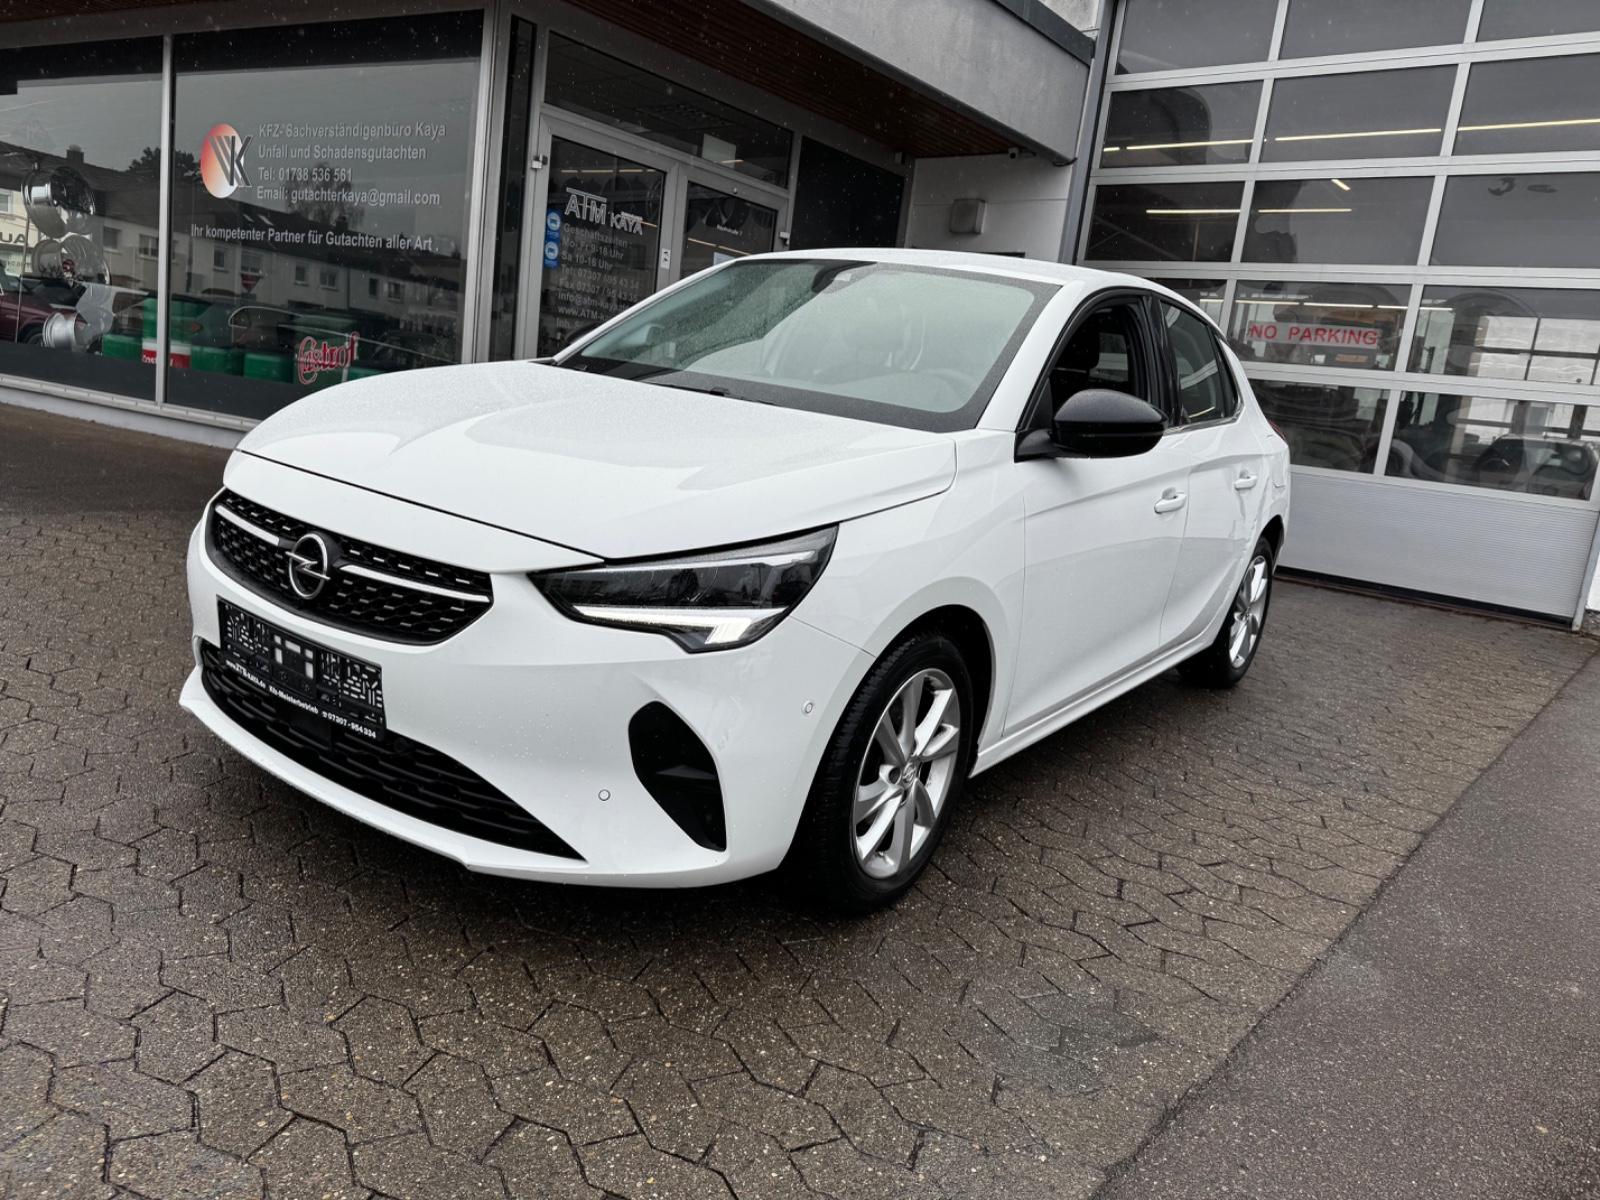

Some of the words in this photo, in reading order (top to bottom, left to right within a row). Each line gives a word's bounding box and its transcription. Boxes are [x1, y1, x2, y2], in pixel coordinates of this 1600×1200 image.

[259, 123, 283, 137] KFZ-
[285, 121, 412, 140] Sachverständigenbüro
[415, 120, 447, 140] Kaya
[258, 144, 288, 159] Unfall
[290, 145, 311, 159] und
[313, 144, 427, 162] Schadensgutachten
[258, 166, 275, 181] Tel:
[312, 167, 331, 182] 536
[334, 167, 352, 182] 561
[257, 185, 288, 200] Email:
[290, 187, 441, 207] gutachterkaya@gmail.com
[564, 187, 607, 225] ATM
[610, 211, 643, 236] KAYA
[191, 223, 204, 237] Ihr
[205, 224, 265, 242] kompetenter
[267, 228, 306, 244] Partner
[308, 230, 323, 245] für
[325, 231, 383, 249] Gutachten
[385, 234, 412, 250] aller
[413, 235, 433, 252] Art
[1249, 324, 1278, 340] NO
[1287, 325, 1378, 346] PARKING
[298, 331, 360, 385] Castrol
